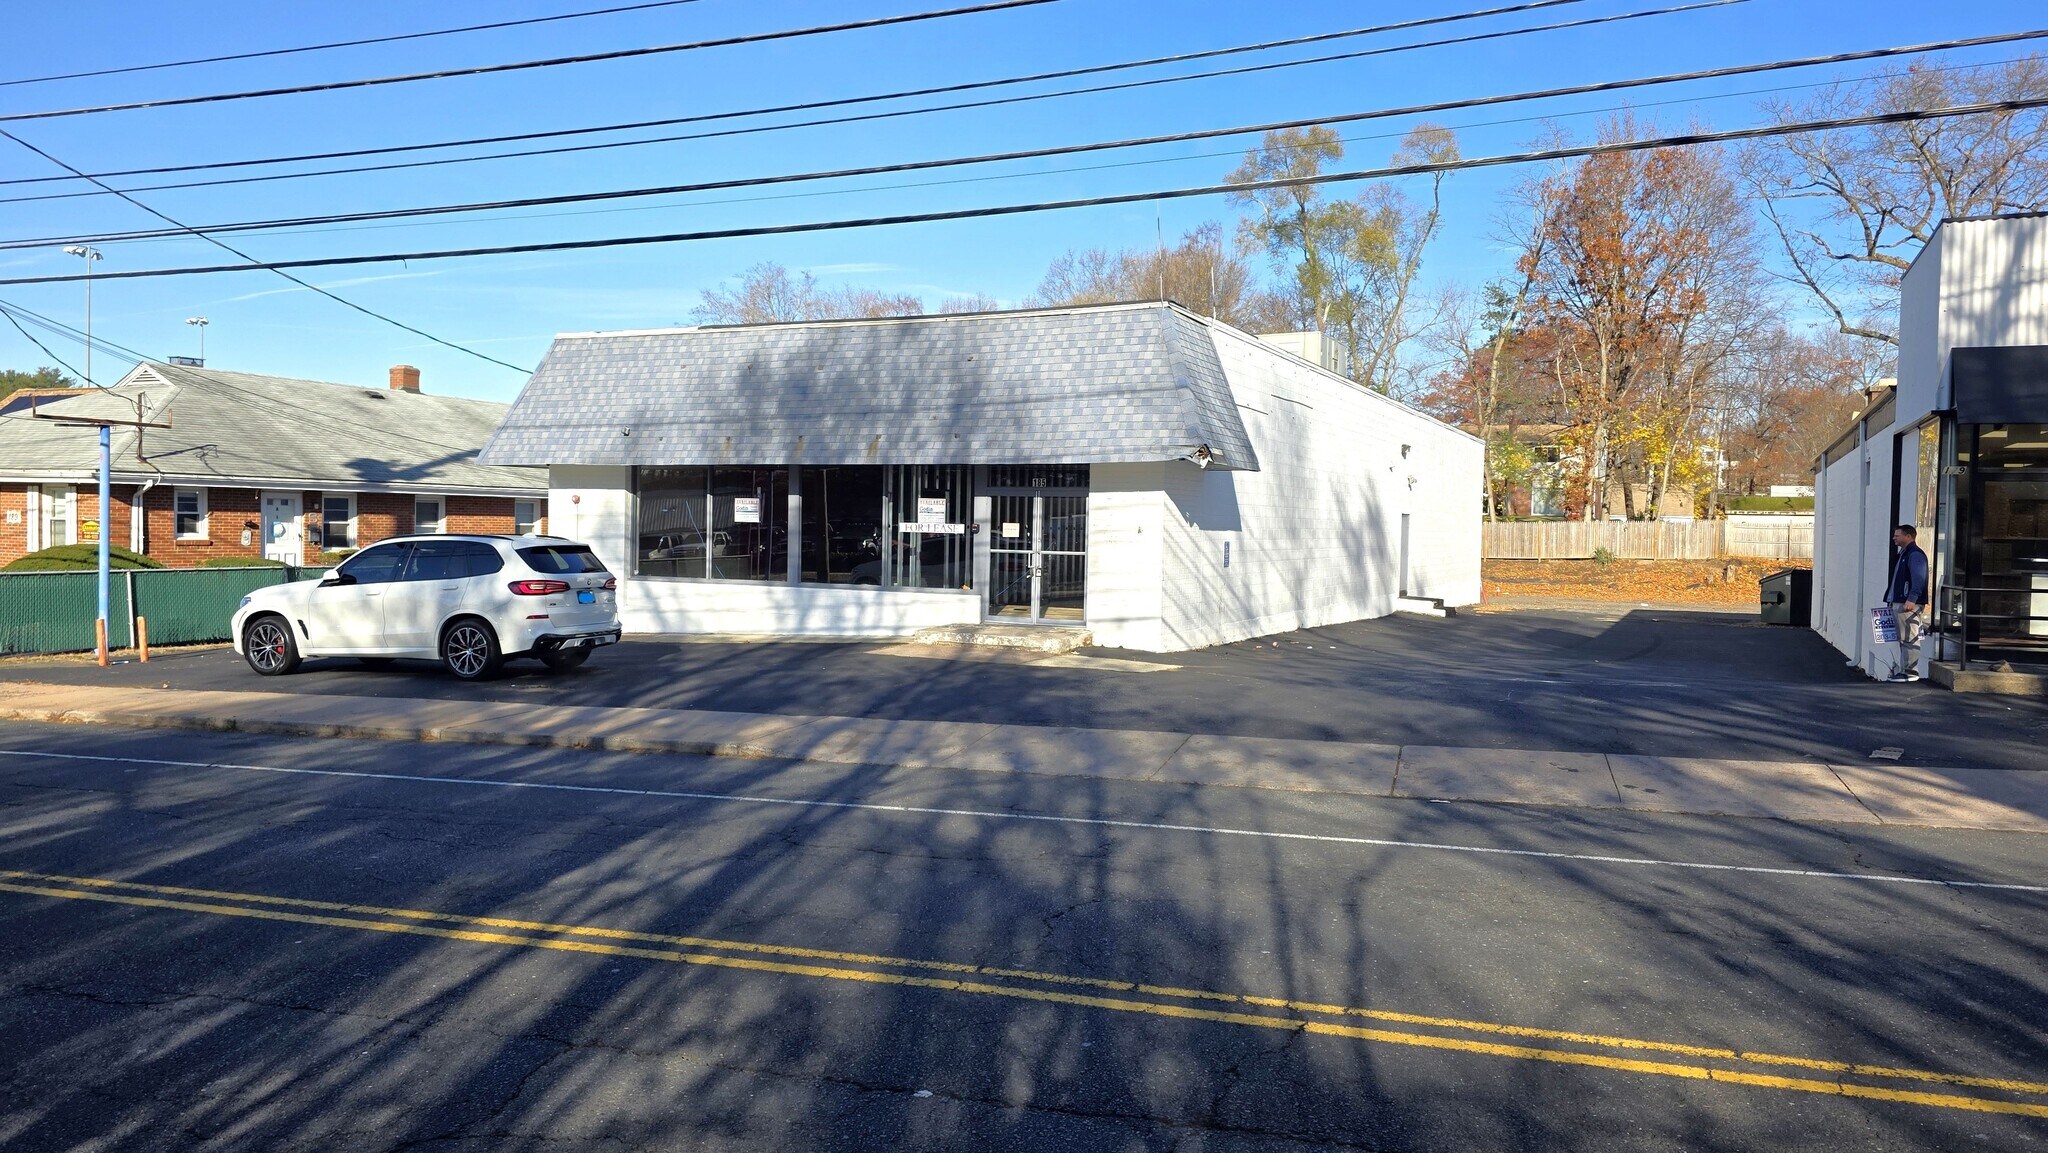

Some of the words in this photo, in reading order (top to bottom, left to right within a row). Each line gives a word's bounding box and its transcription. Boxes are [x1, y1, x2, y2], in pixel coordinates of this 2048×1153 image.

[1034, 479, 1046, 487] 185
[905, 524, 924, 532] FOR
[927, 524, 960, 533] LEASE
[1873, 609, 1894, 617] AVAI
[1874, 618, 1897, 626] Godi
